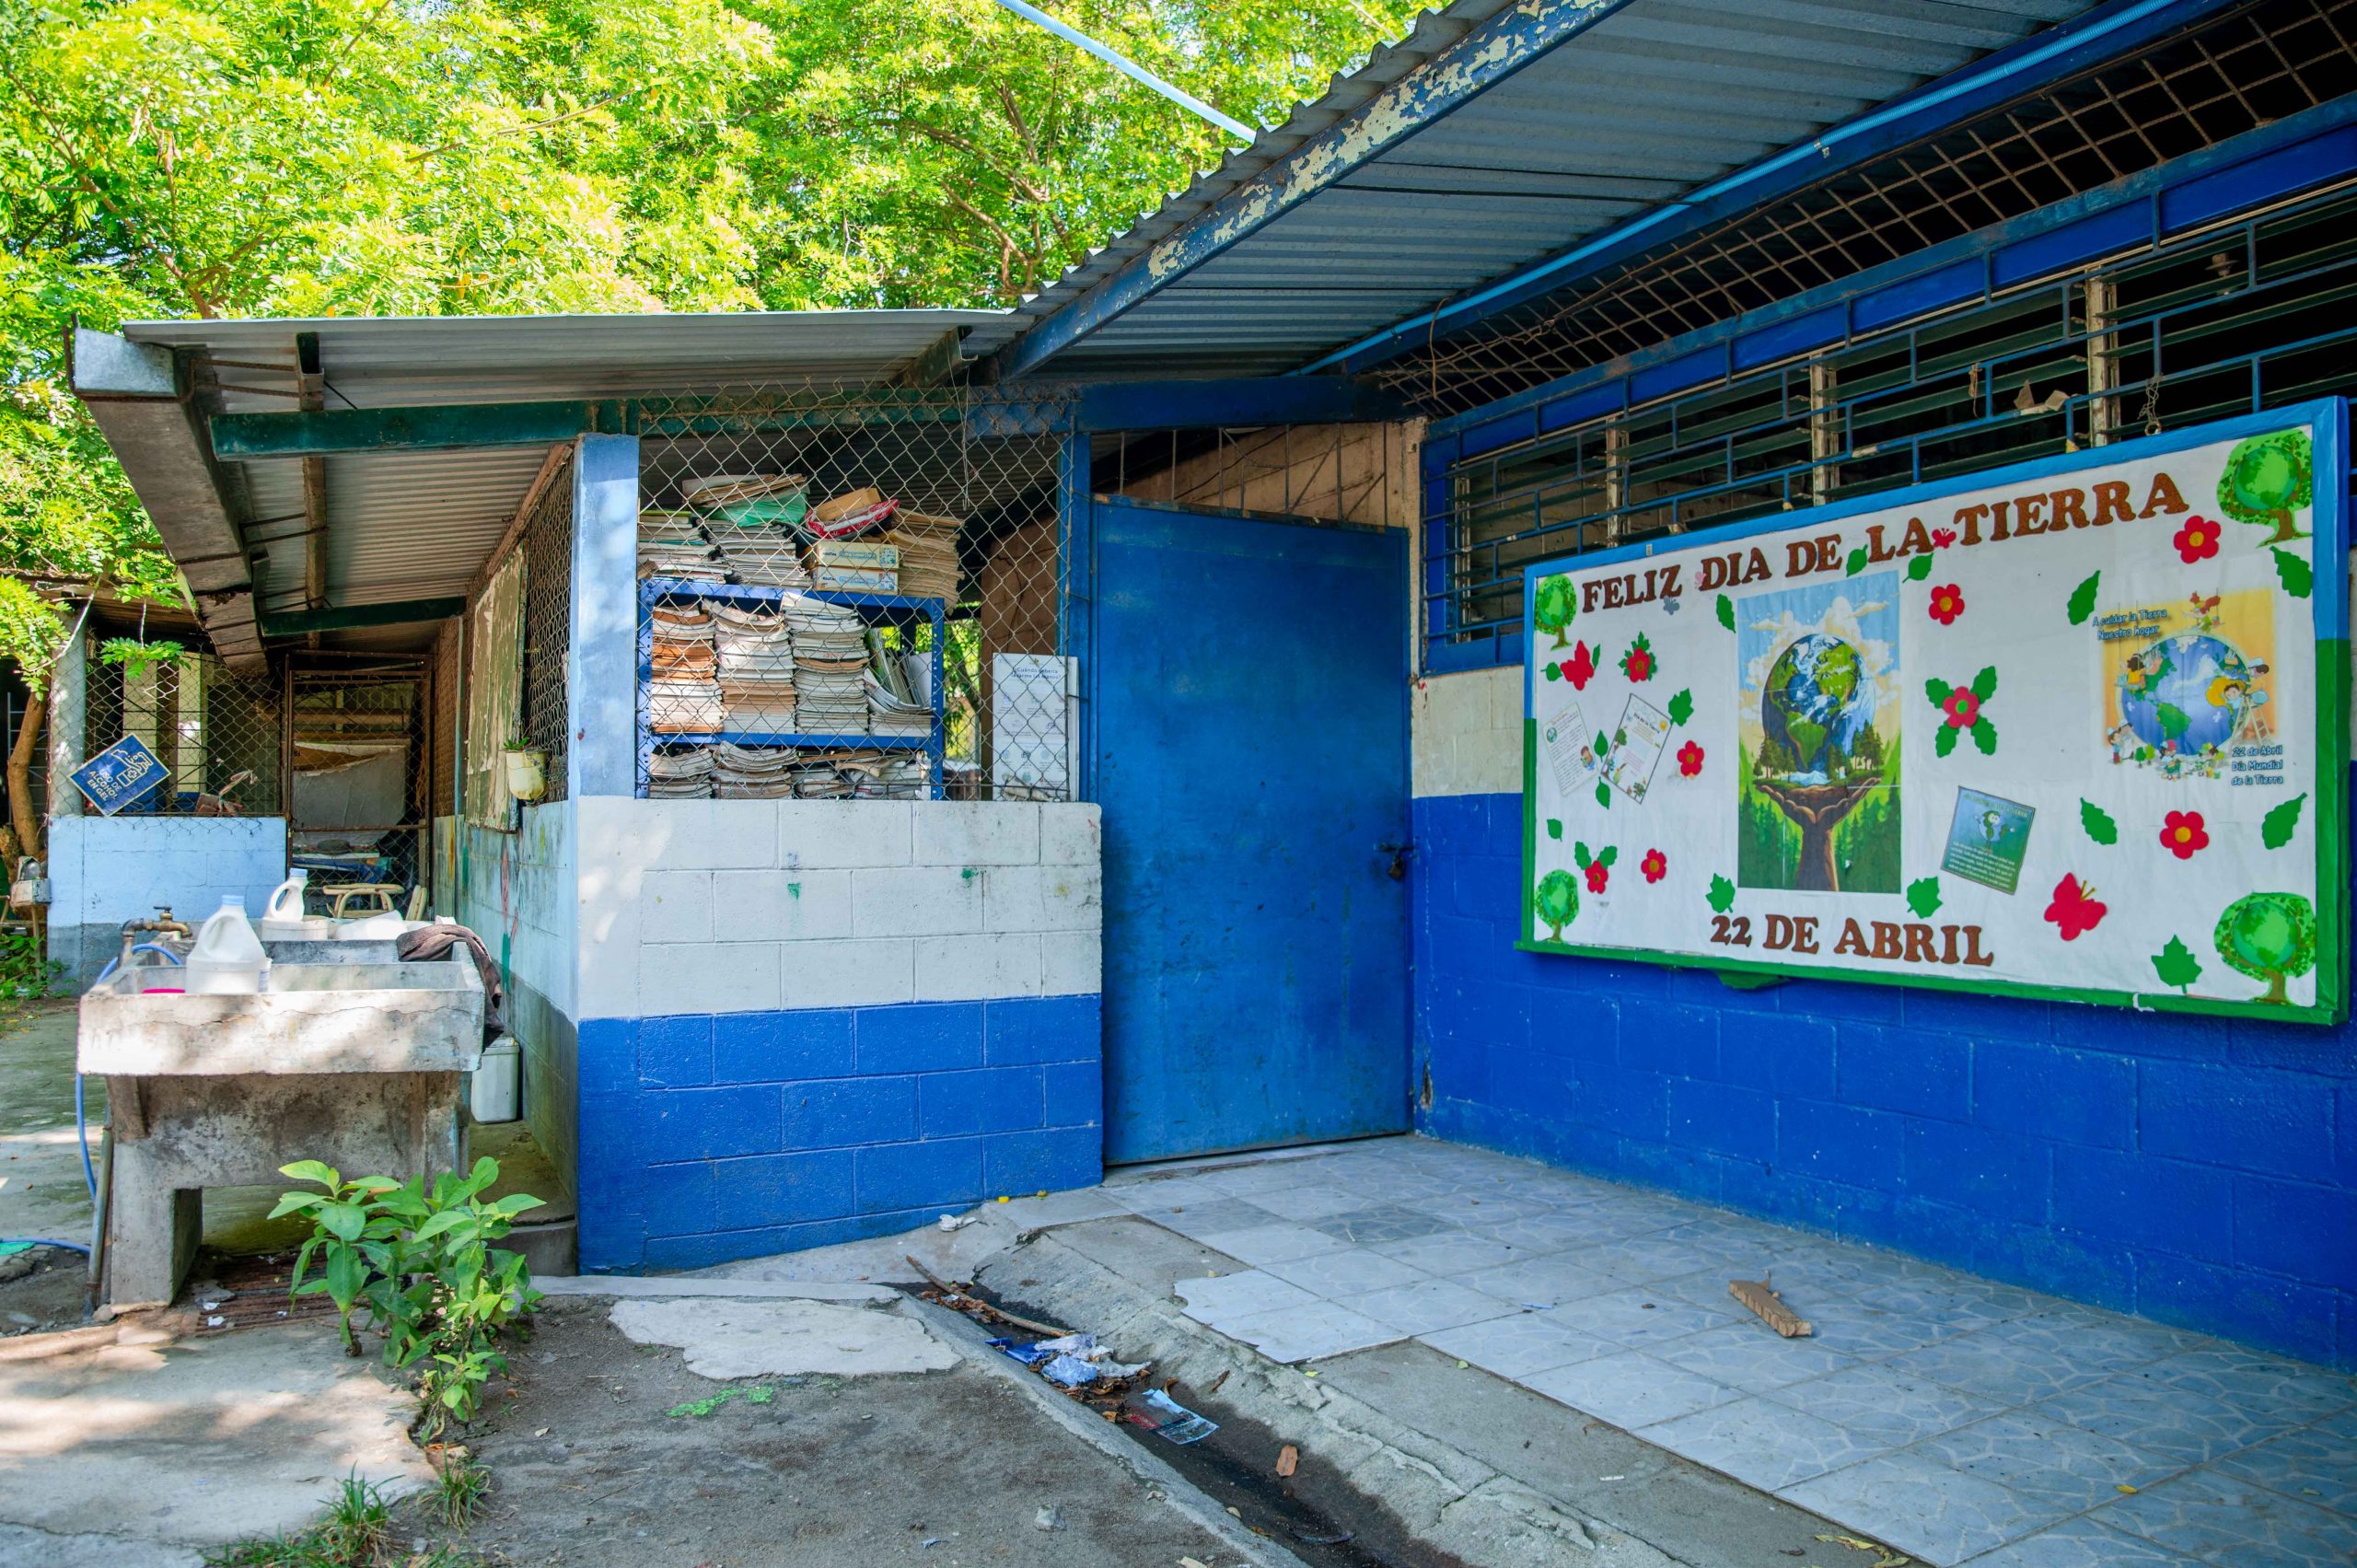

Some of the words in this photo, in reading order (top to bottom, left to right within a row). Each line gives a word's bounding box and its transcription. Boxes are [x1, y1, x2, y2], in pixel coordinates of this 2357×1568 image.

[1582, 564, 1682, 613] FELIZ
[1698, 547, 1772, 592] DIA
[1784, 534, 1842, 578] DE
[1865, 517, 1934, 563] LA
[1953, 472, 2189, 546] TIERRA
[2100, 613, 2127, 625] cuidar
[2139, 609, 2167, 621] Tierra
[2097, 628, 2131, 641] Nuestro
[2134, 625, 2159, 637] hogar
[2232, 747, 2246, 757] 22
[2247, 747, 2258, 756] de
[2260, 745, 2282, 756] Abril
[2247, 760, 2283, 771] Mundial
[88, 771, 118, 800] ALCOHOL
[99, 768, 113, 783] USO
[110, 782, 122, 792] DE
[2231, 776, 2243, 785] de
[2254, 774, 2283, 784] Tierra
[87, 779, 99, 789] EN
[96, 788, 109, 801] GEL
[1710, 915, 1752, 947] 22
[1762, 913, 1819, 955] DE
[1833, 917, 1994, 967] ABRIL
